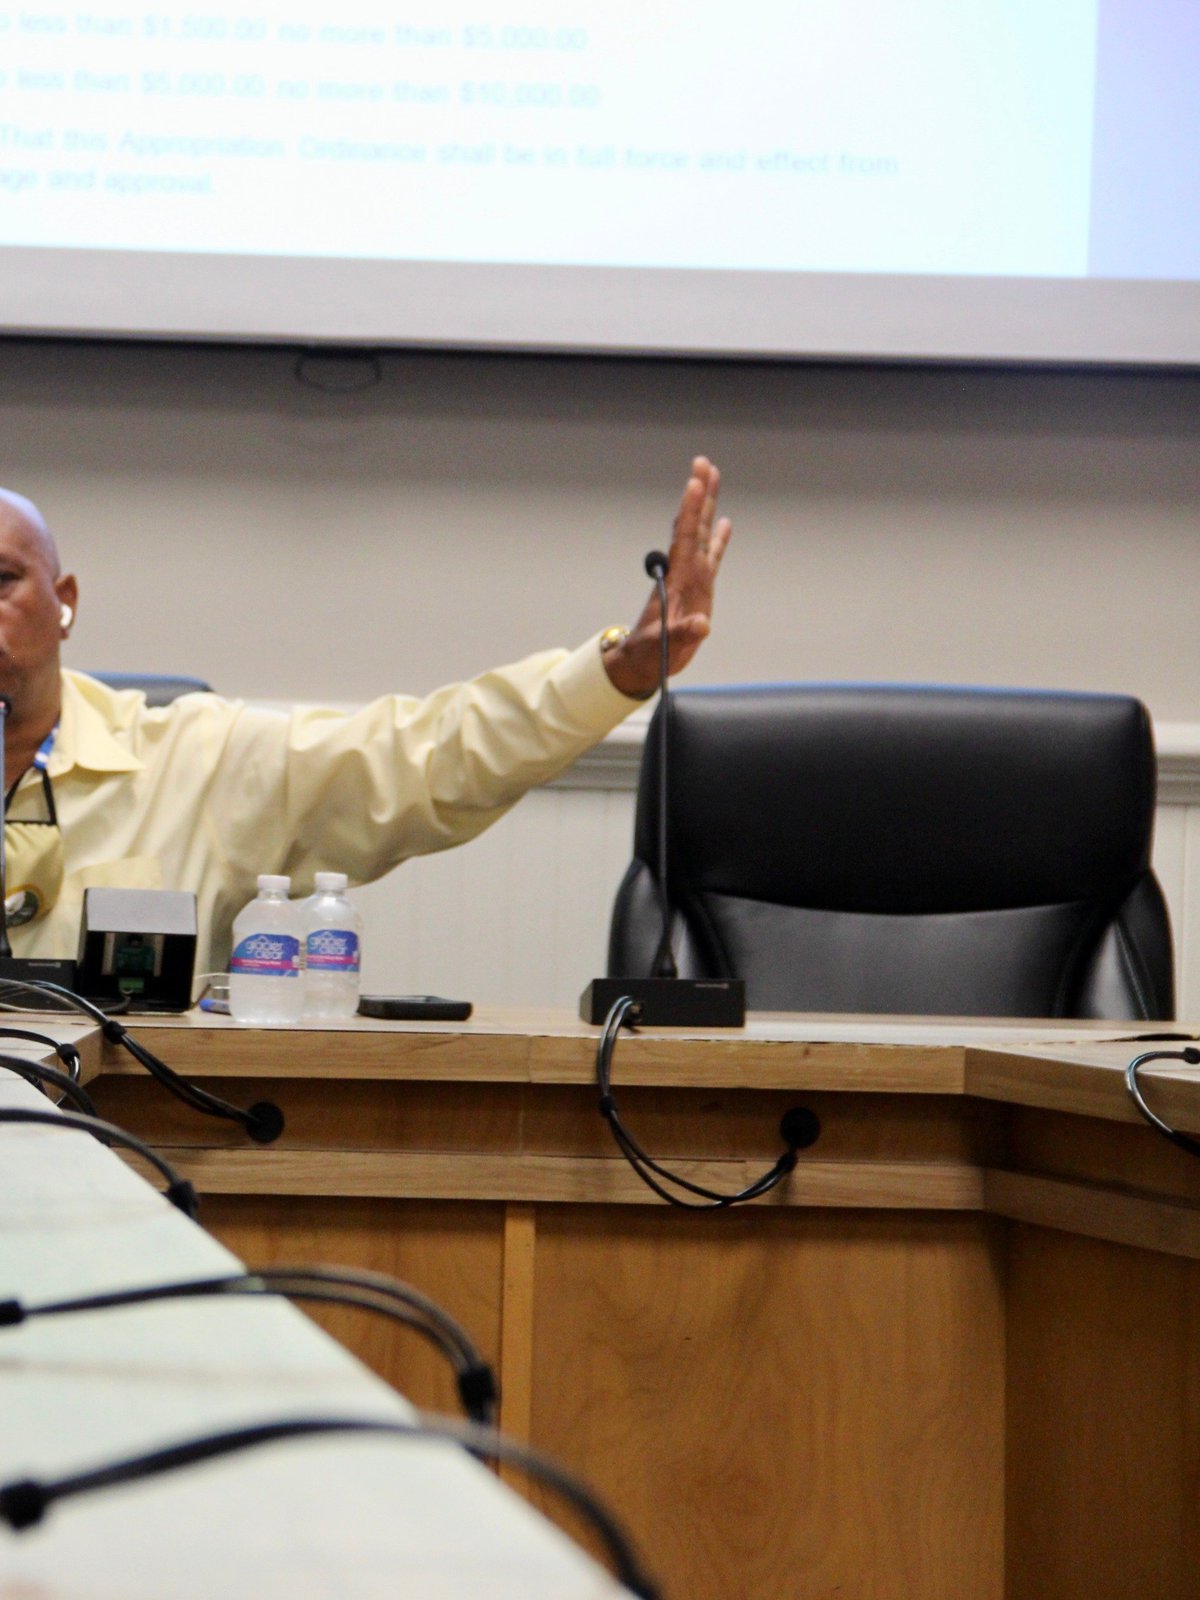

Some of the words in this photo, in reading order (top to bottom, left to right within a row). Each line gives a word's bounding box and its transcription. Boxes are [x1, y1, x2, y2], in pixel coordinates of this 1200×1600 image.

[18, 10, 67, 33] less
[75, 14, 132, 35] than
[277, 23, 311, 42] no
[318, 26, 386, 45] more
[394, 22, 451, 47] than
[15, 66, 65, 89] less
[73, 68, 130, 92] than
[275, 79, 310, 98] no
[316, 81, 385, 101] more
[392, 79, 449, 103] than
[0, 122, 53, 149] That
[64, 127, 108, 152] this
[298, 134, 427, 161] Ordinance
[436, 140, 496, 165] shall
[502, 142, 536, 166] be
[543, 145, 568, 167] in
[575, 144, 616, 169] full
[624, 146, 690, 171] force
[697, 147, 748, 172] and
[755, 146, 830, 175] effect
[837, 149, 900, 177] from
[47, 168, 98, 191] and
